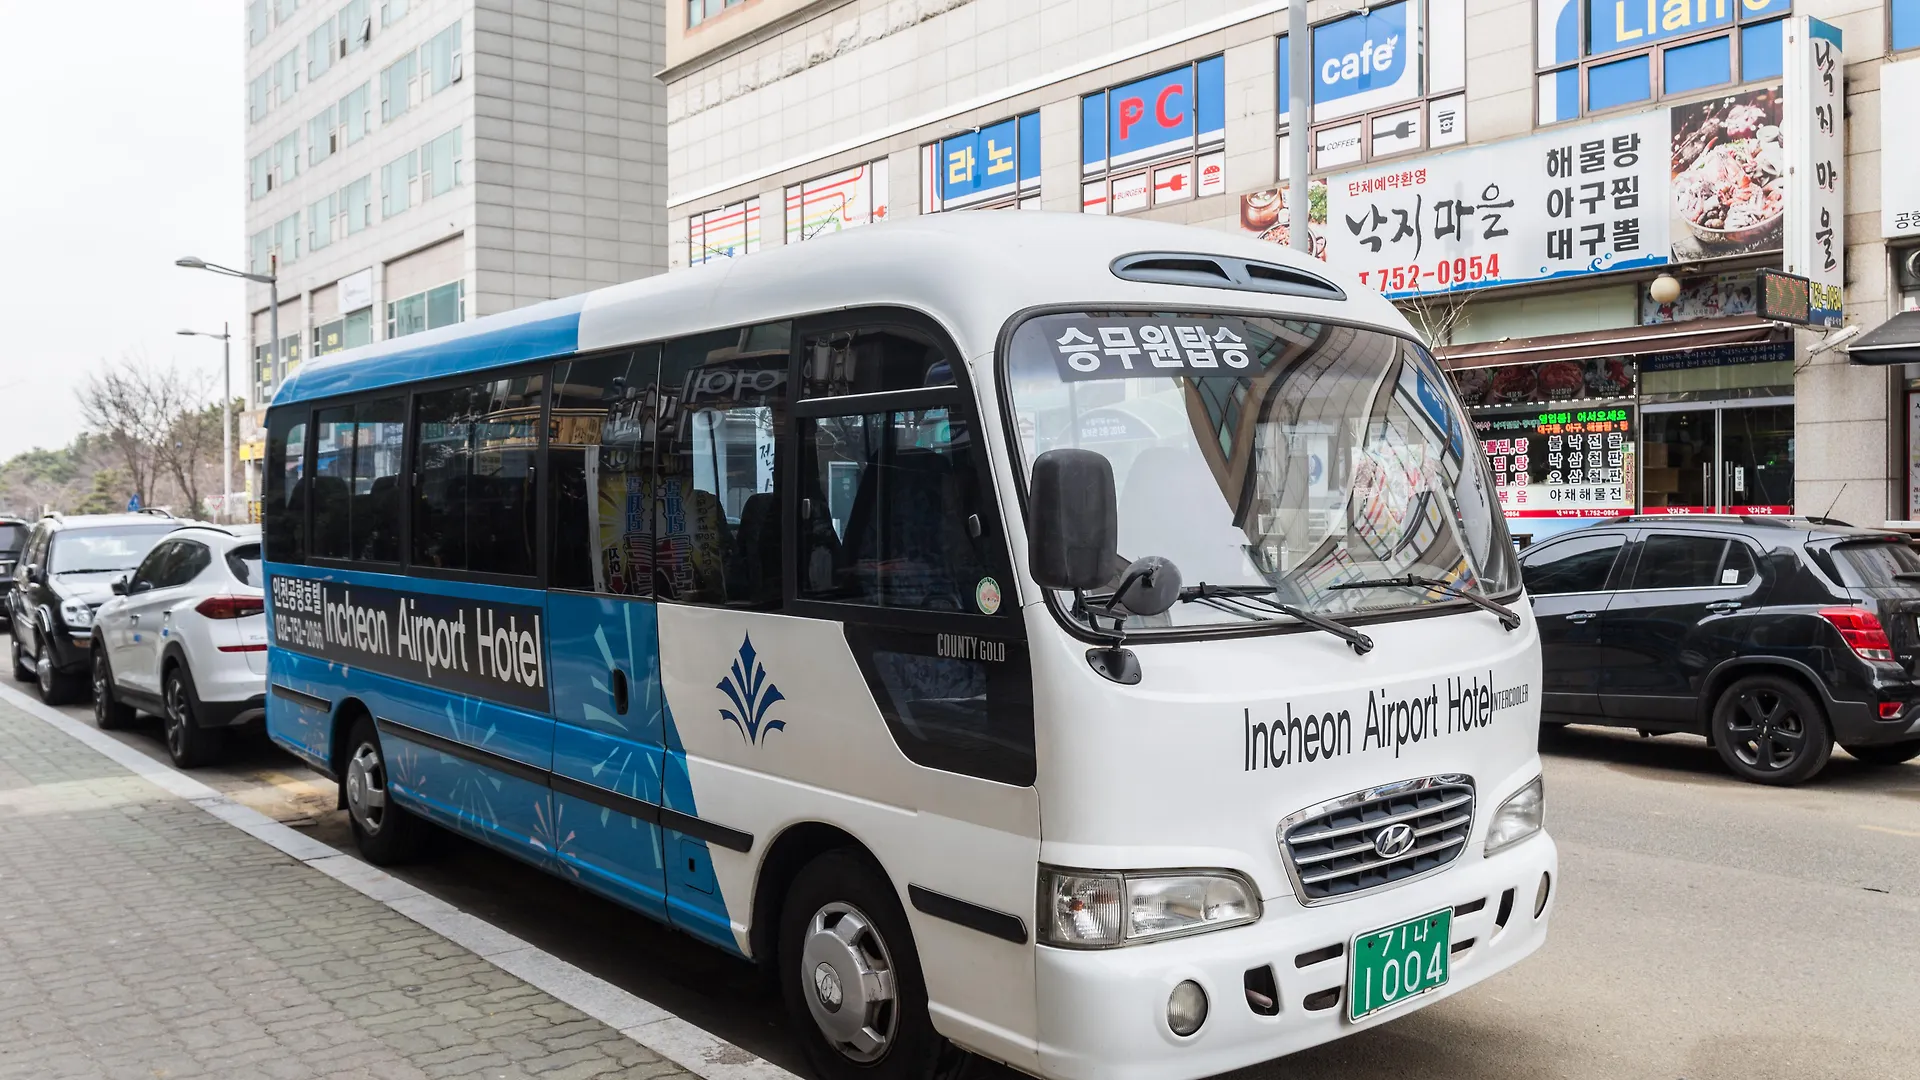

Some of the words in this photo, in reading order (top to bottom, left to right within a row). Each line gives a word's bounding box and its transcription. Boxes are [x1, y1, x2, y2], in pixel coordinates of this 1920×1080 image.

[1119, 84, 1184, 140] PC
[1326, 137, 1356, 151] COFFEE
[1546, 132, 1641, 178] 해물탕
[1116, 187, 1143, 200] BURGER
[1348, 168, 1427, 196] 단체예약환영
[1546, 175, 1640, 218] 아구찜
[1345, 183, 1515, 261] 낙지마을
[1546, 217, 1640, 261] 대구뽈
[1056, 325, 1250, 372] 승무원탑승
[1577, 410, 1627, 422] 어서오세요
[1549, 487, 1622, 501] 야채해물전
[273, 576, 321, 615] 인천공항호텔
[324, 588, 390, 656] Incheon
[398, 598, 468, 678] Airport
[476, 607, 544, 688] Hotel
[937, 633, 978, 660] COUNTY
[980, 640, 1005, 662] GOLD
[1244, 702, 1351, 771] Incheon
[1363, 684, 1438, 759] Airport
[1447, 669, 1493, 734] Hotel
[1379, 919, 1429, 957] 71나
[1365, 941, 1443, 1011] 1004
